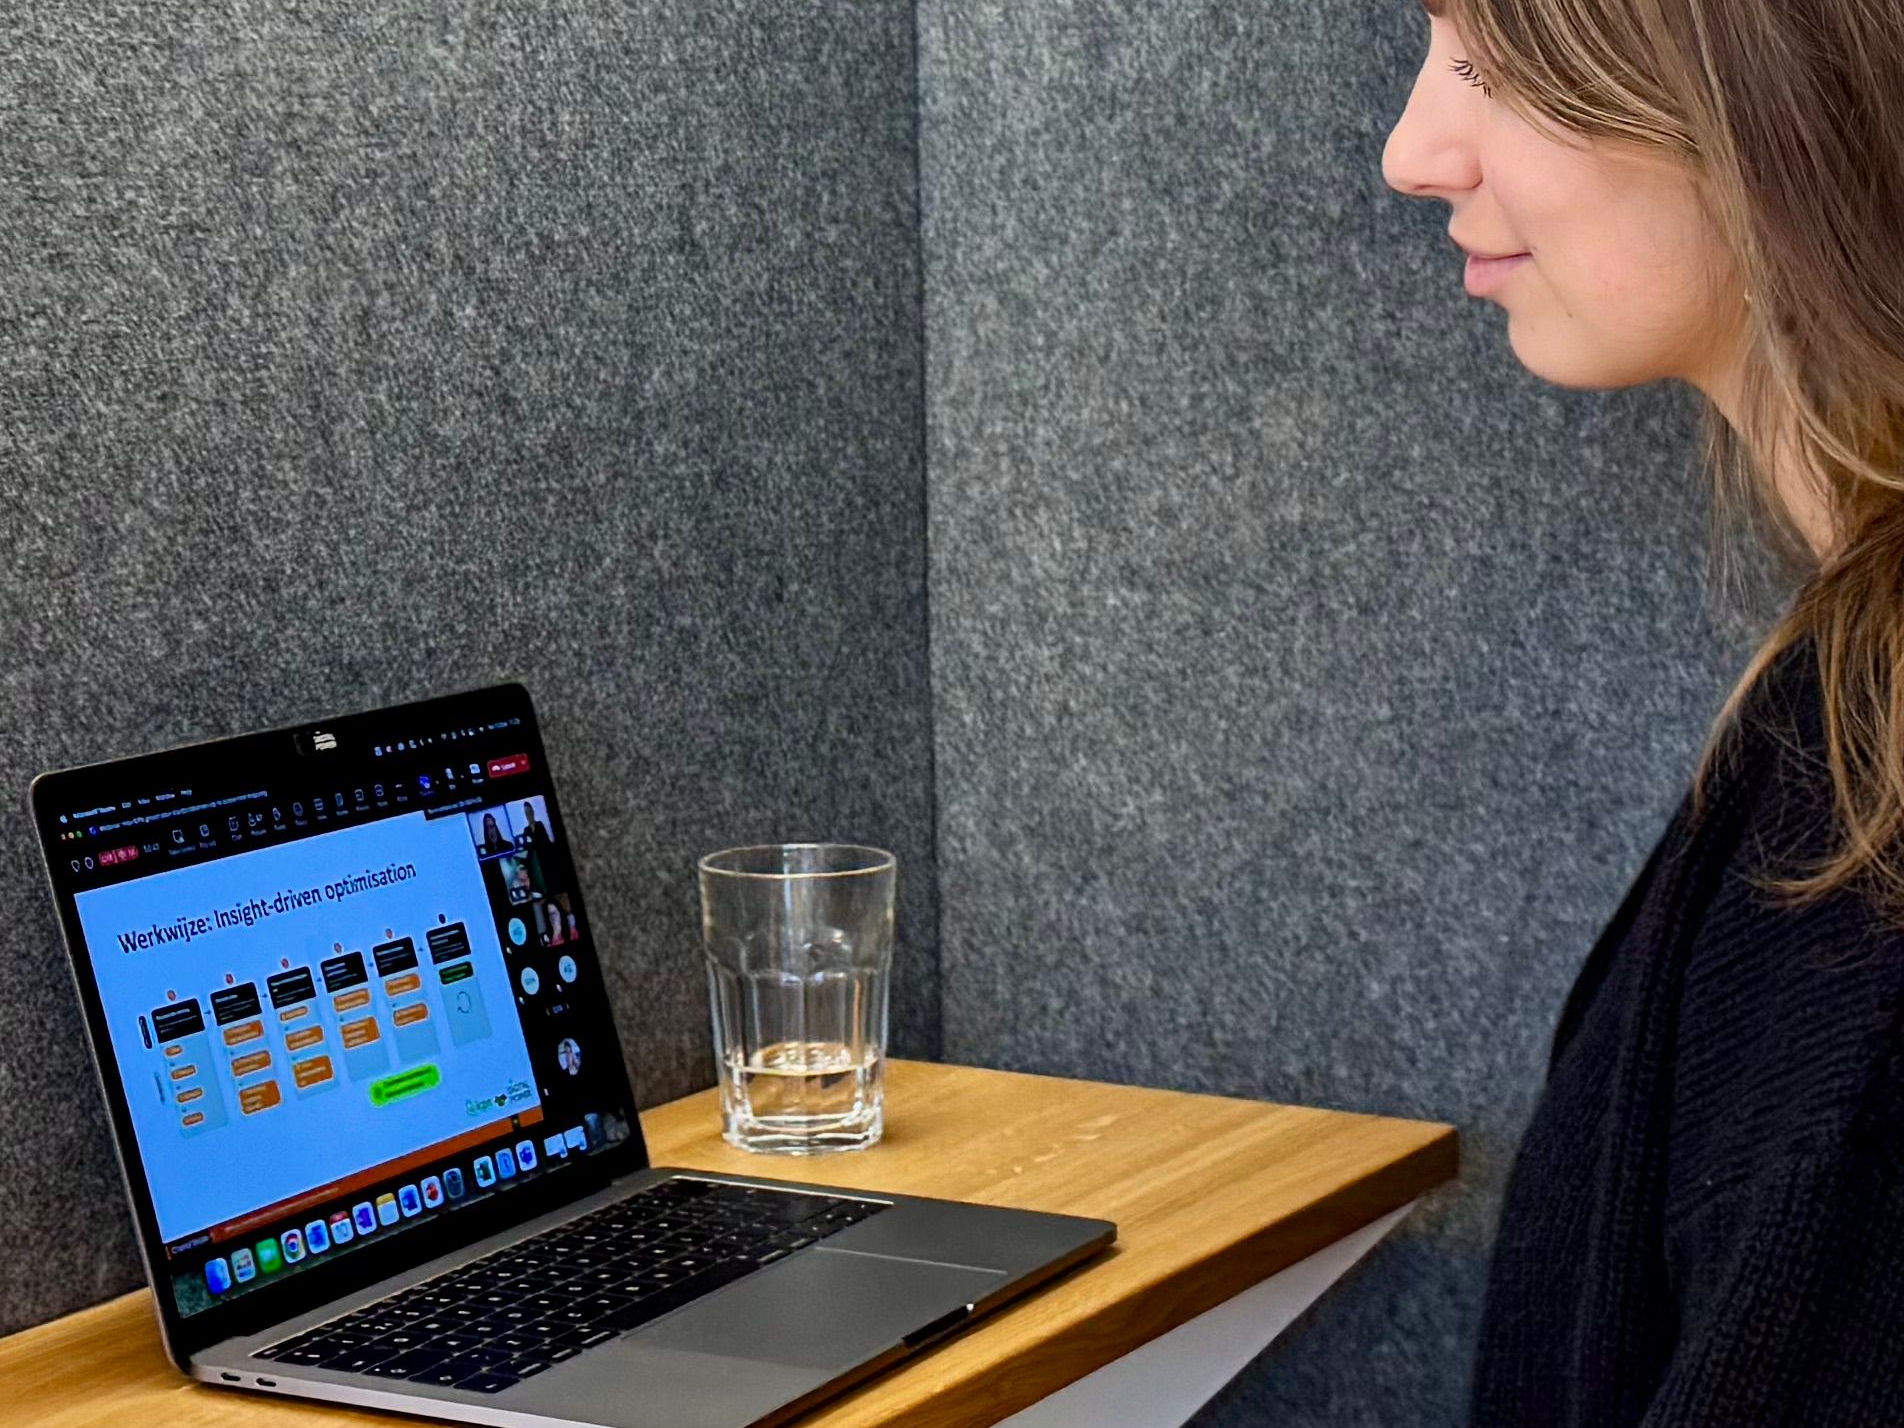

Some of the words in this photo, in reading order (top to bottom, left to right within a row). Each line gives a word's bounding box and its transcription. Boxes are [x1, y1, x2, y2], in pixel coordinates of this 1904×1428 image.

[117, 916, 213, 955] Werkwijze:
[213, 888, 322, 927] Insight-driven
[325, 863, 417, 902] optimisation
